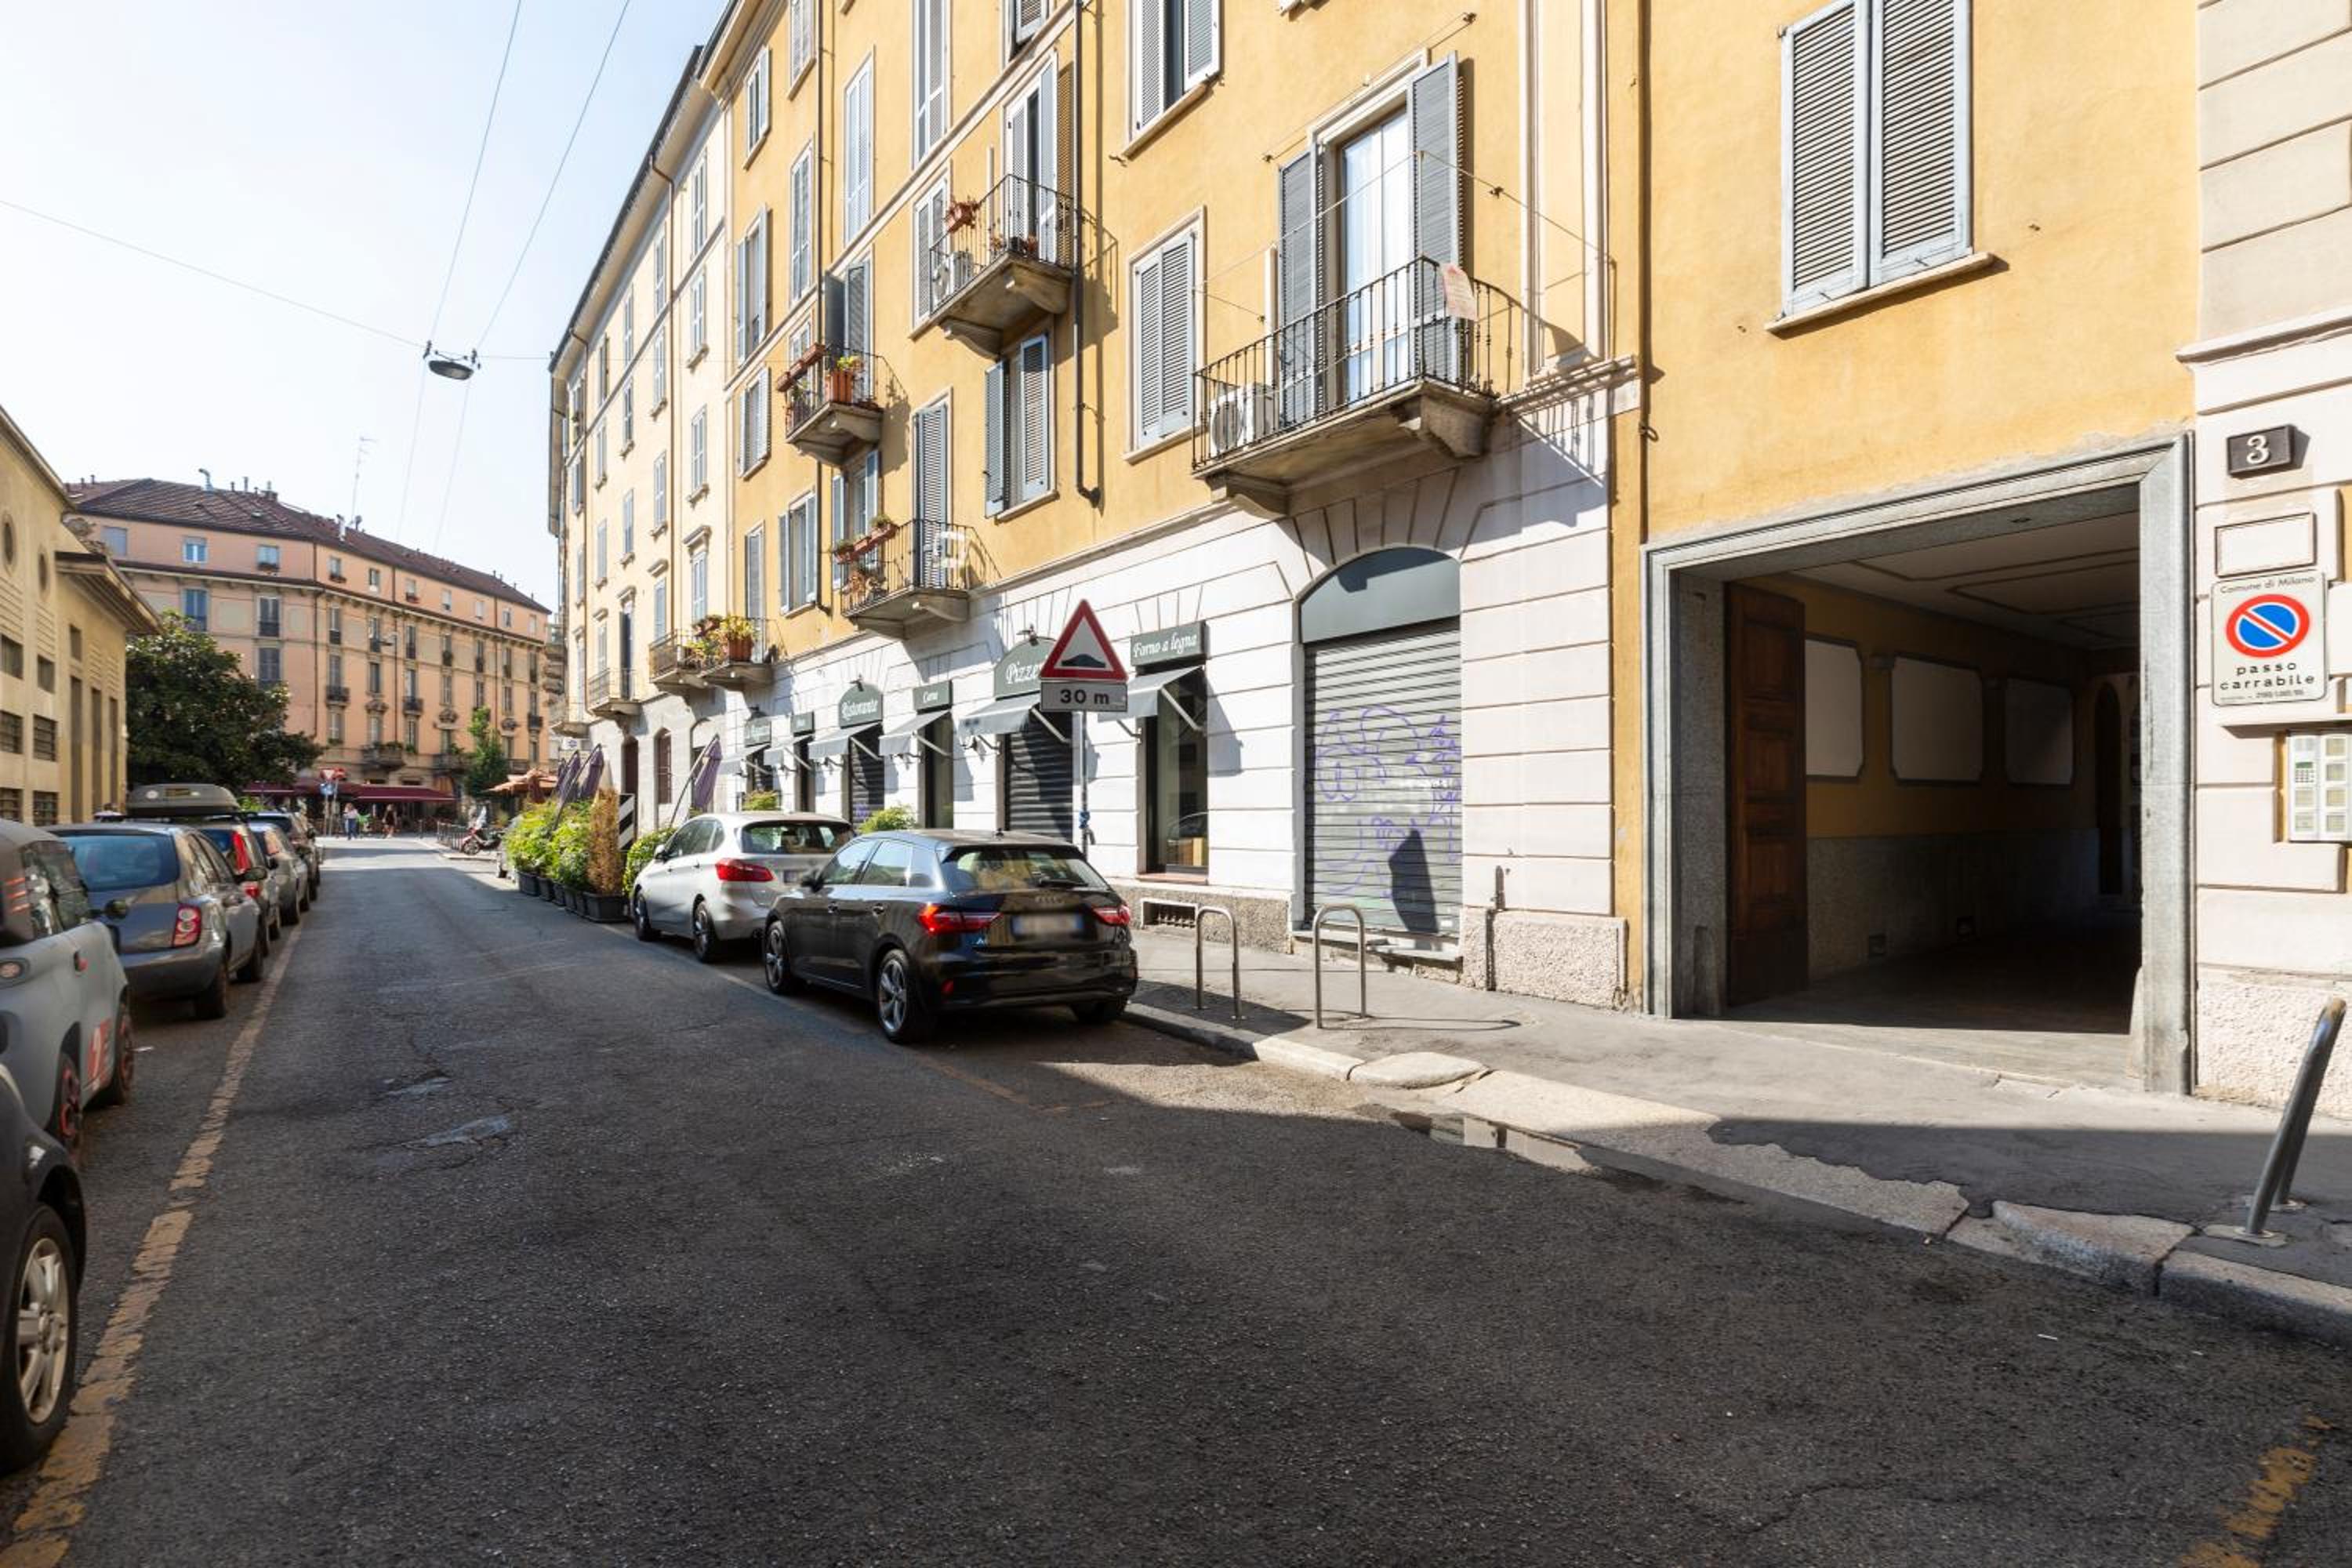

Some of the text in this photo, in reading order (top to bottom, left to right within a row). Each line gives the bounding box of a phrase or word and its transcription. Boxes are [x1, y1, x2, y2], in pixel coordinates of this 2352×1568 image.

[2246, 434, 2269, 464] 3
[2220, 576, 2316, 593] Comune di Milano
[1133, 631, 1197, 659] Forno a legna
[1005, 660, 1044, 684] Pizze
[2236, 662, 2296, 677] passo
[2220, 673, 2315, 691] carrabile
[1059, 688, 1109, 705] 30 m
